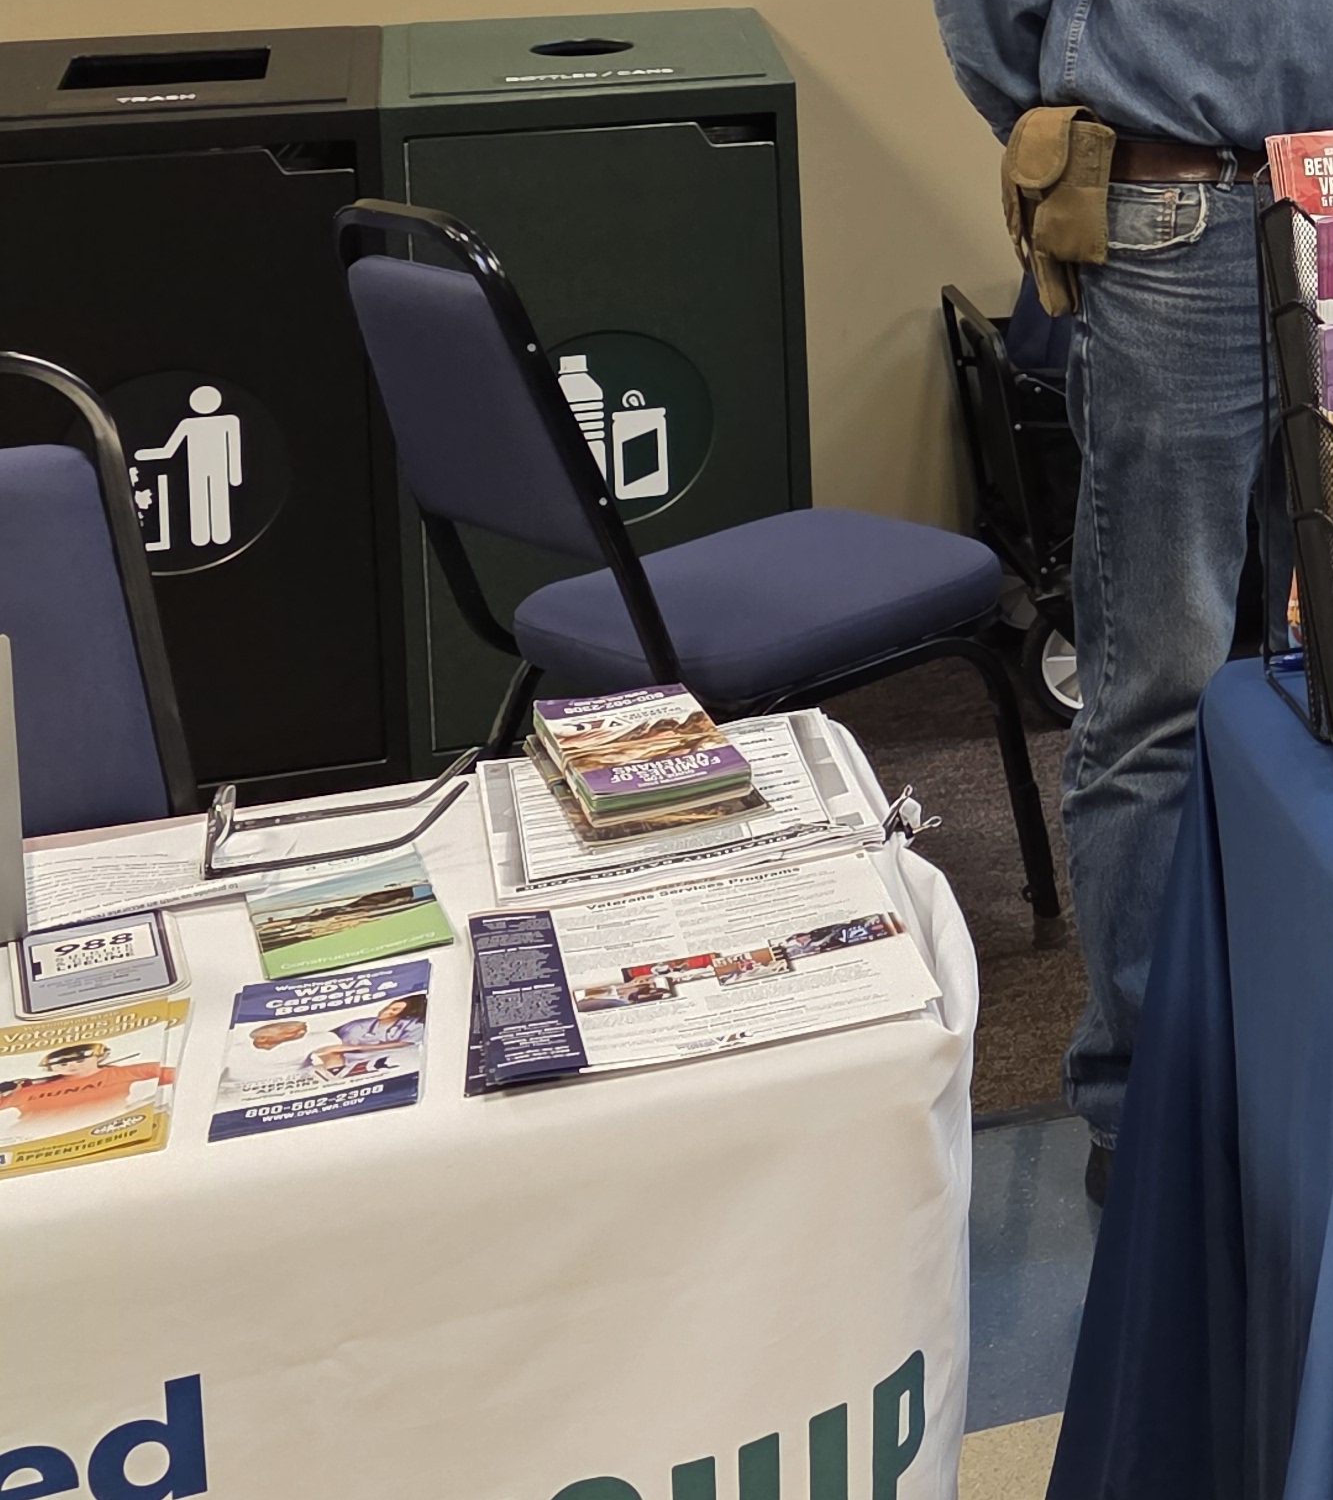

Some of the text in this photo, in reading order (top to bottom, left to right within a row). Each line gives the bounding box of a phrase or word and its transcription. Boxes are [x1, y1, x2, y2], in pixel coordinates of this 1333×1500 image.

[117, 93, 196, 103] TRASH
[610, 770, 634, 783] OF
[586, 867, 800, 911] Veterans Services Programs
[54, 932, 134, 956] 988
[264, 980, 398, 1010] Careers &
[294, 978, 373, 997] WDVA
[275, 992, 387, 1016] Benefits
[3, 1012, 138, 1044] Veterans in
[15, 1129, 138, 1163] APPRENTICESHIP
